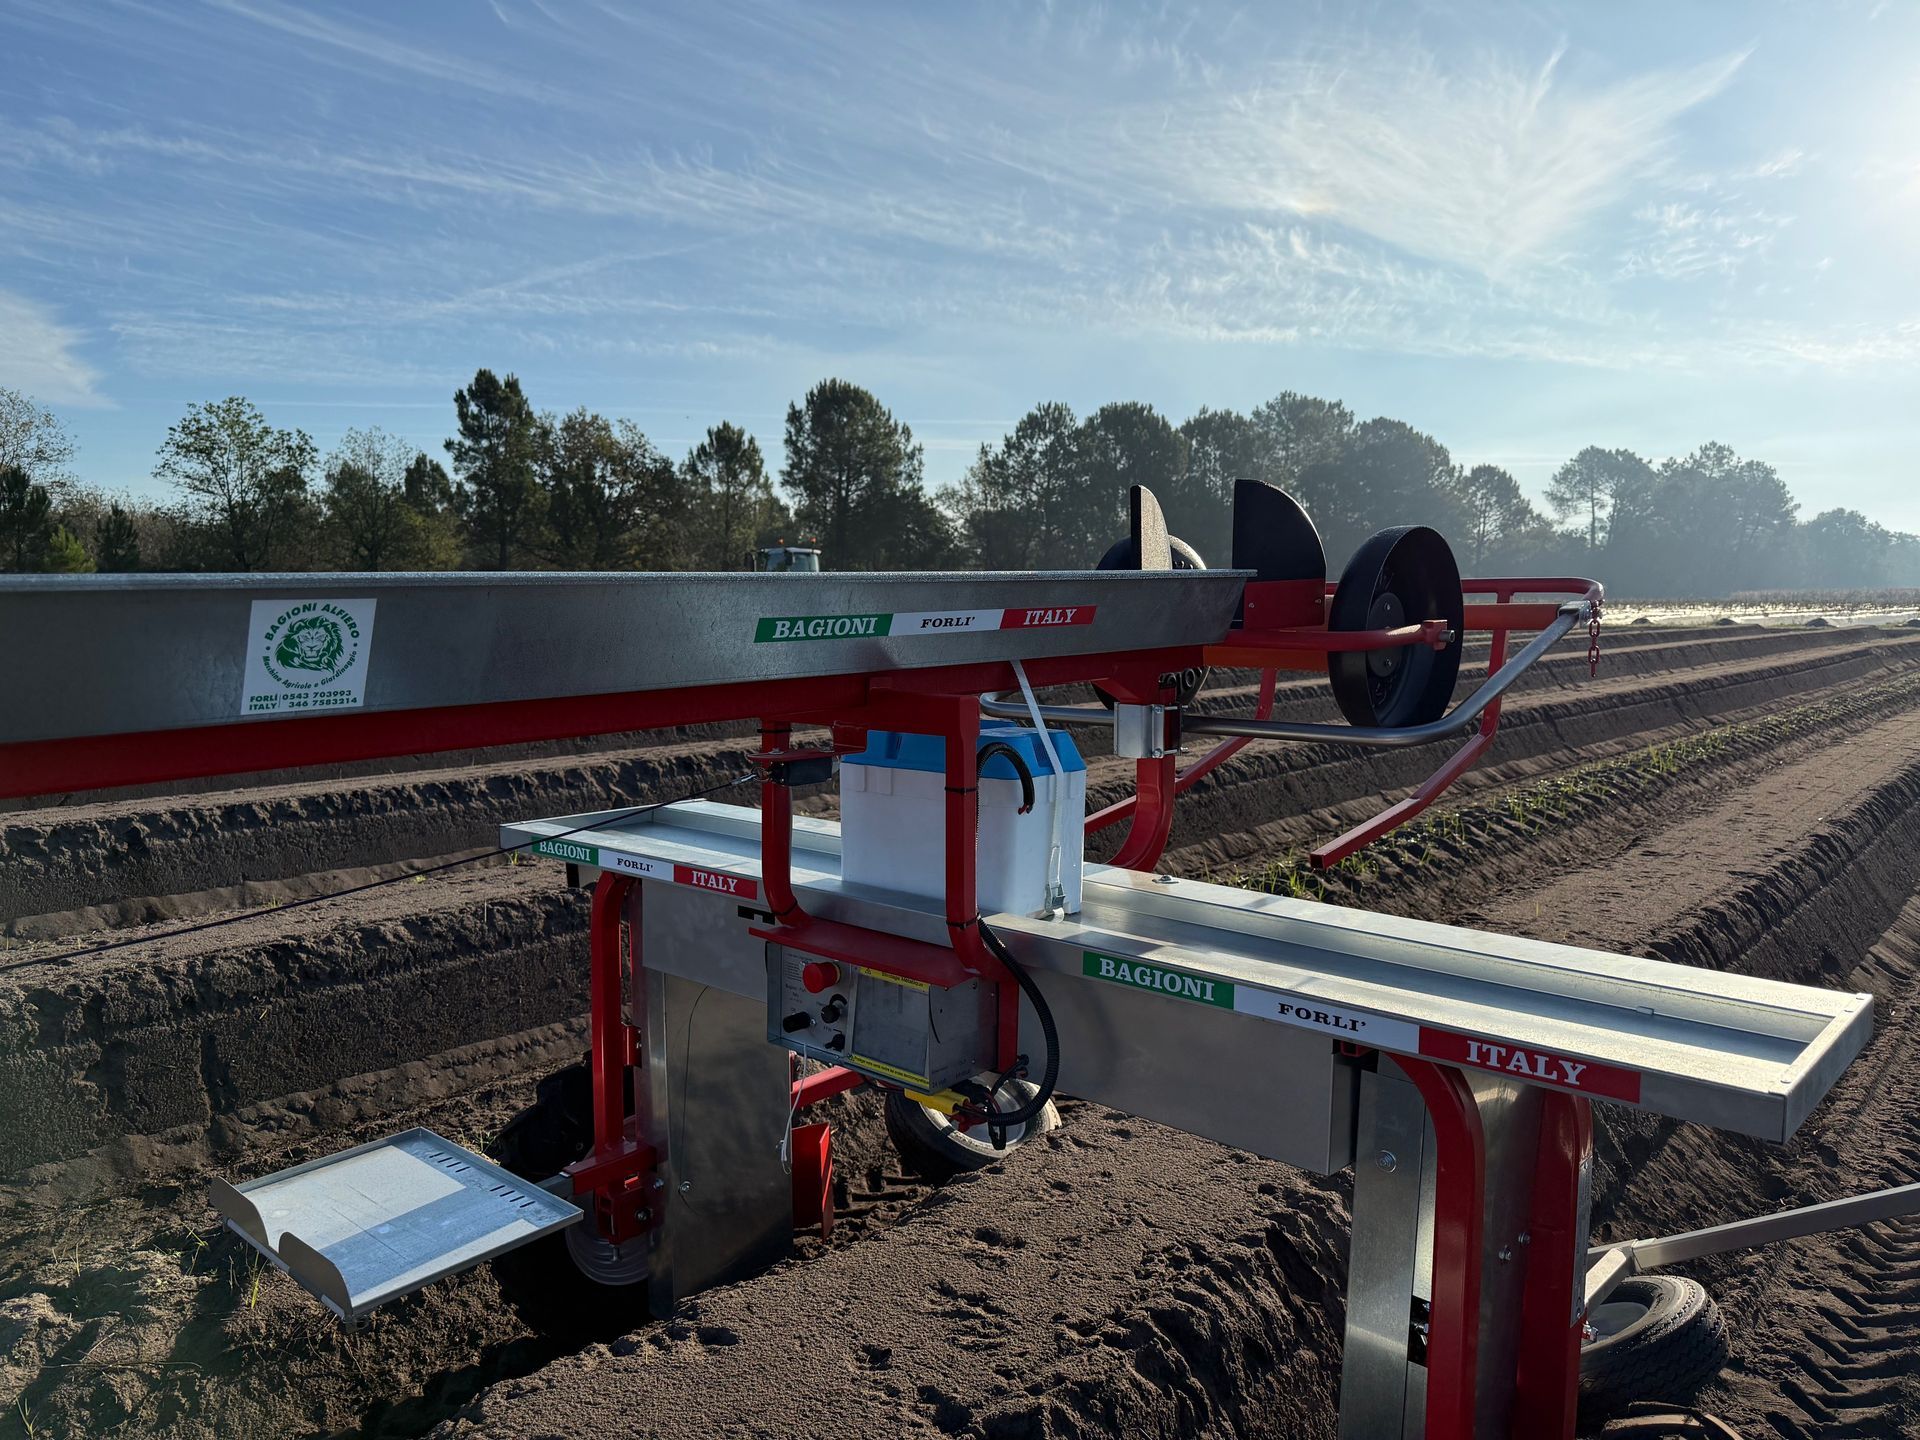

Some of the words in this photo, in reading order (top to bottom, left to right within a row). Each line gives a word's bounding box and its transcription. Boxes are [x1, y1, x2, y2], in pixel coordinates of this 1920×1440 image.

[265, 602, 318, 641] BAGIONI
[321, 603, 360, 639] ALFIERO
[772, 617, 878, 639] BAGIONI
[1023, 608, 1077, 625] ITALY
[282, 679, 312, 689] Agricole
[321, 650, 357, 686] Giardinaggio
[248, 702, 277, 711] ITALY
[312, 698, 358, 706] 7583214
[282, 693, 309, 701] 0543
[312, 690, 352, 699] 703993
[539, 840, 592, 863] BAGIONI
[691, 870, 739, 893] ITALY
[1098, 957, 1216, 1003] BAGIONI
[1466, 1039, 1589, 1087] ITALY
